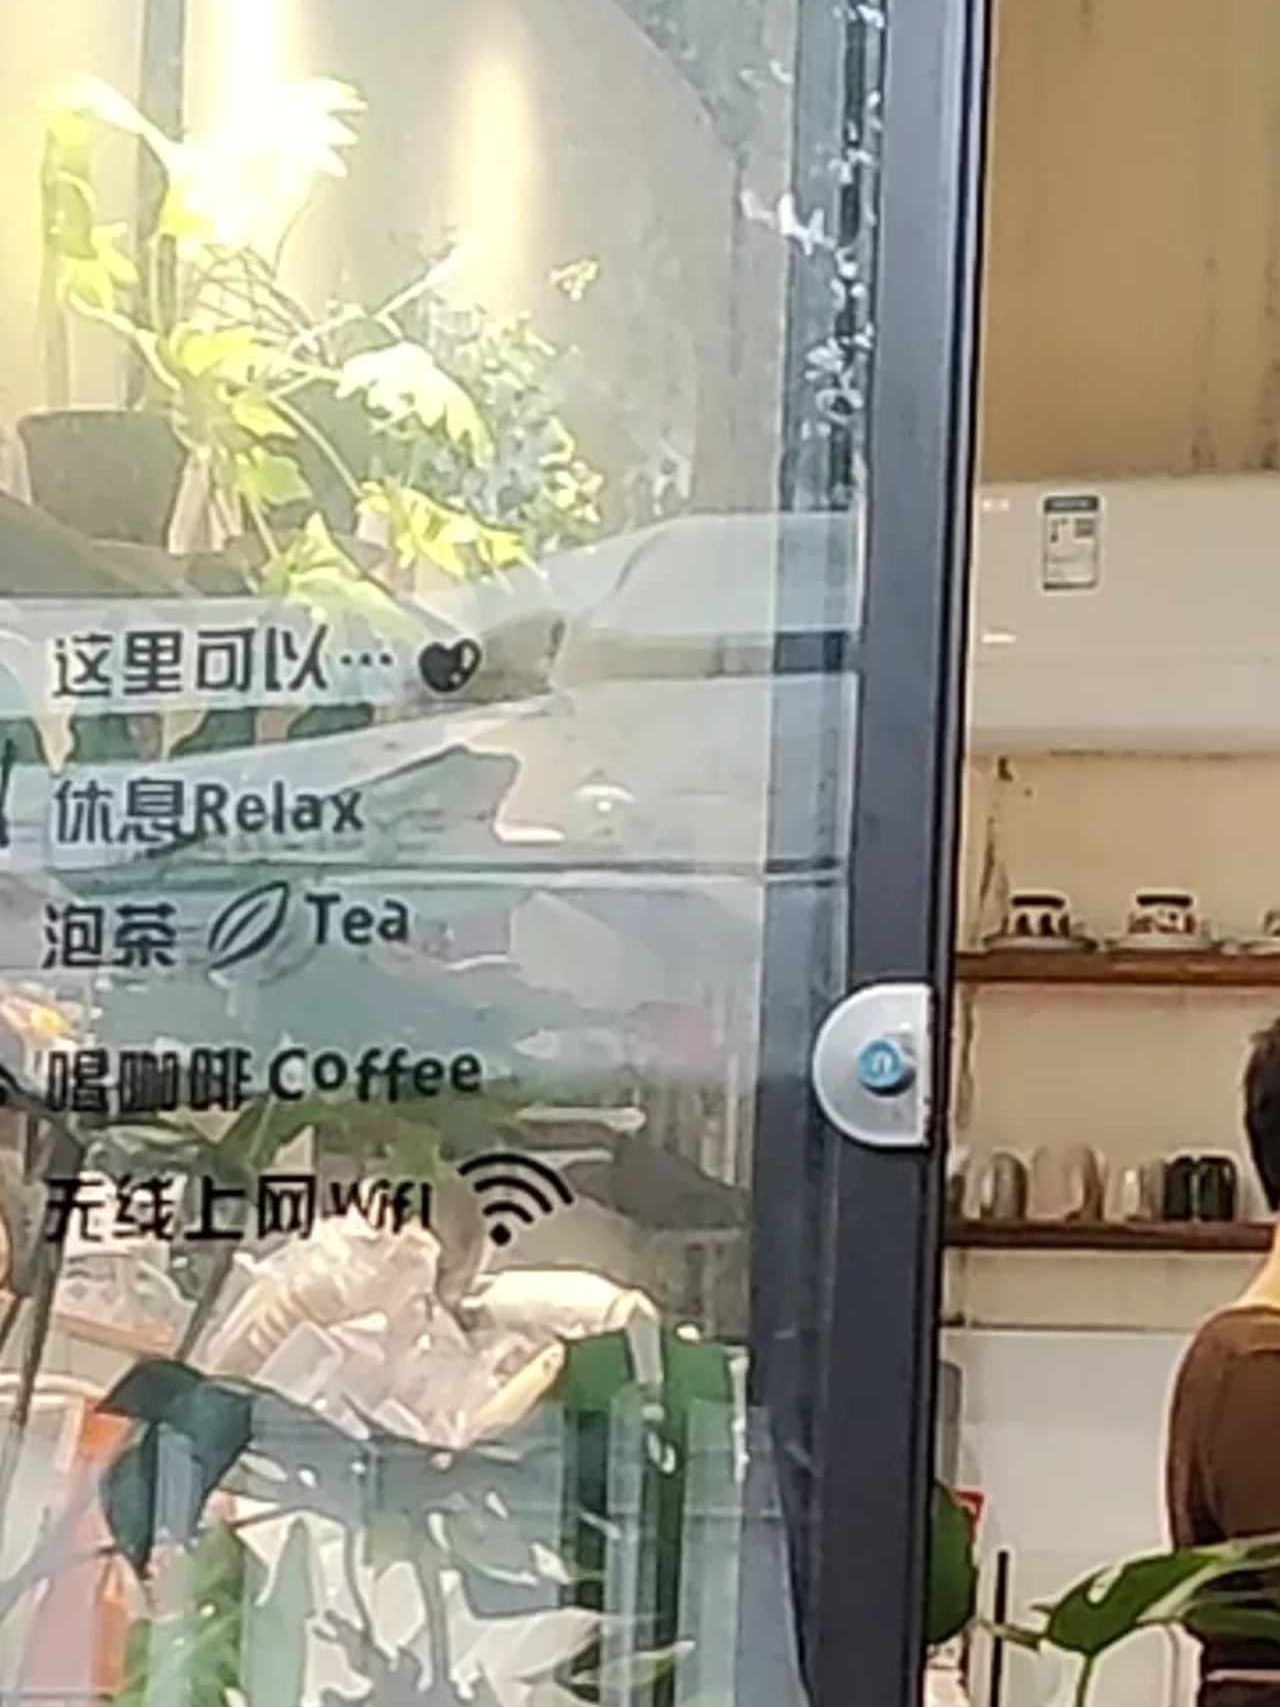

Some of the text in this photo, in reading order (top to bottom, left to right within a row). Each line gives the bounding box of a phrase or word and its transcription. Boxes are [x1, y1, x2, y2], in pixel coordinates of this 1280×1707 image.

[42, 893, 410, 970] 泡茶 Tea
[268, 1046, 482, 1103] Coffee
